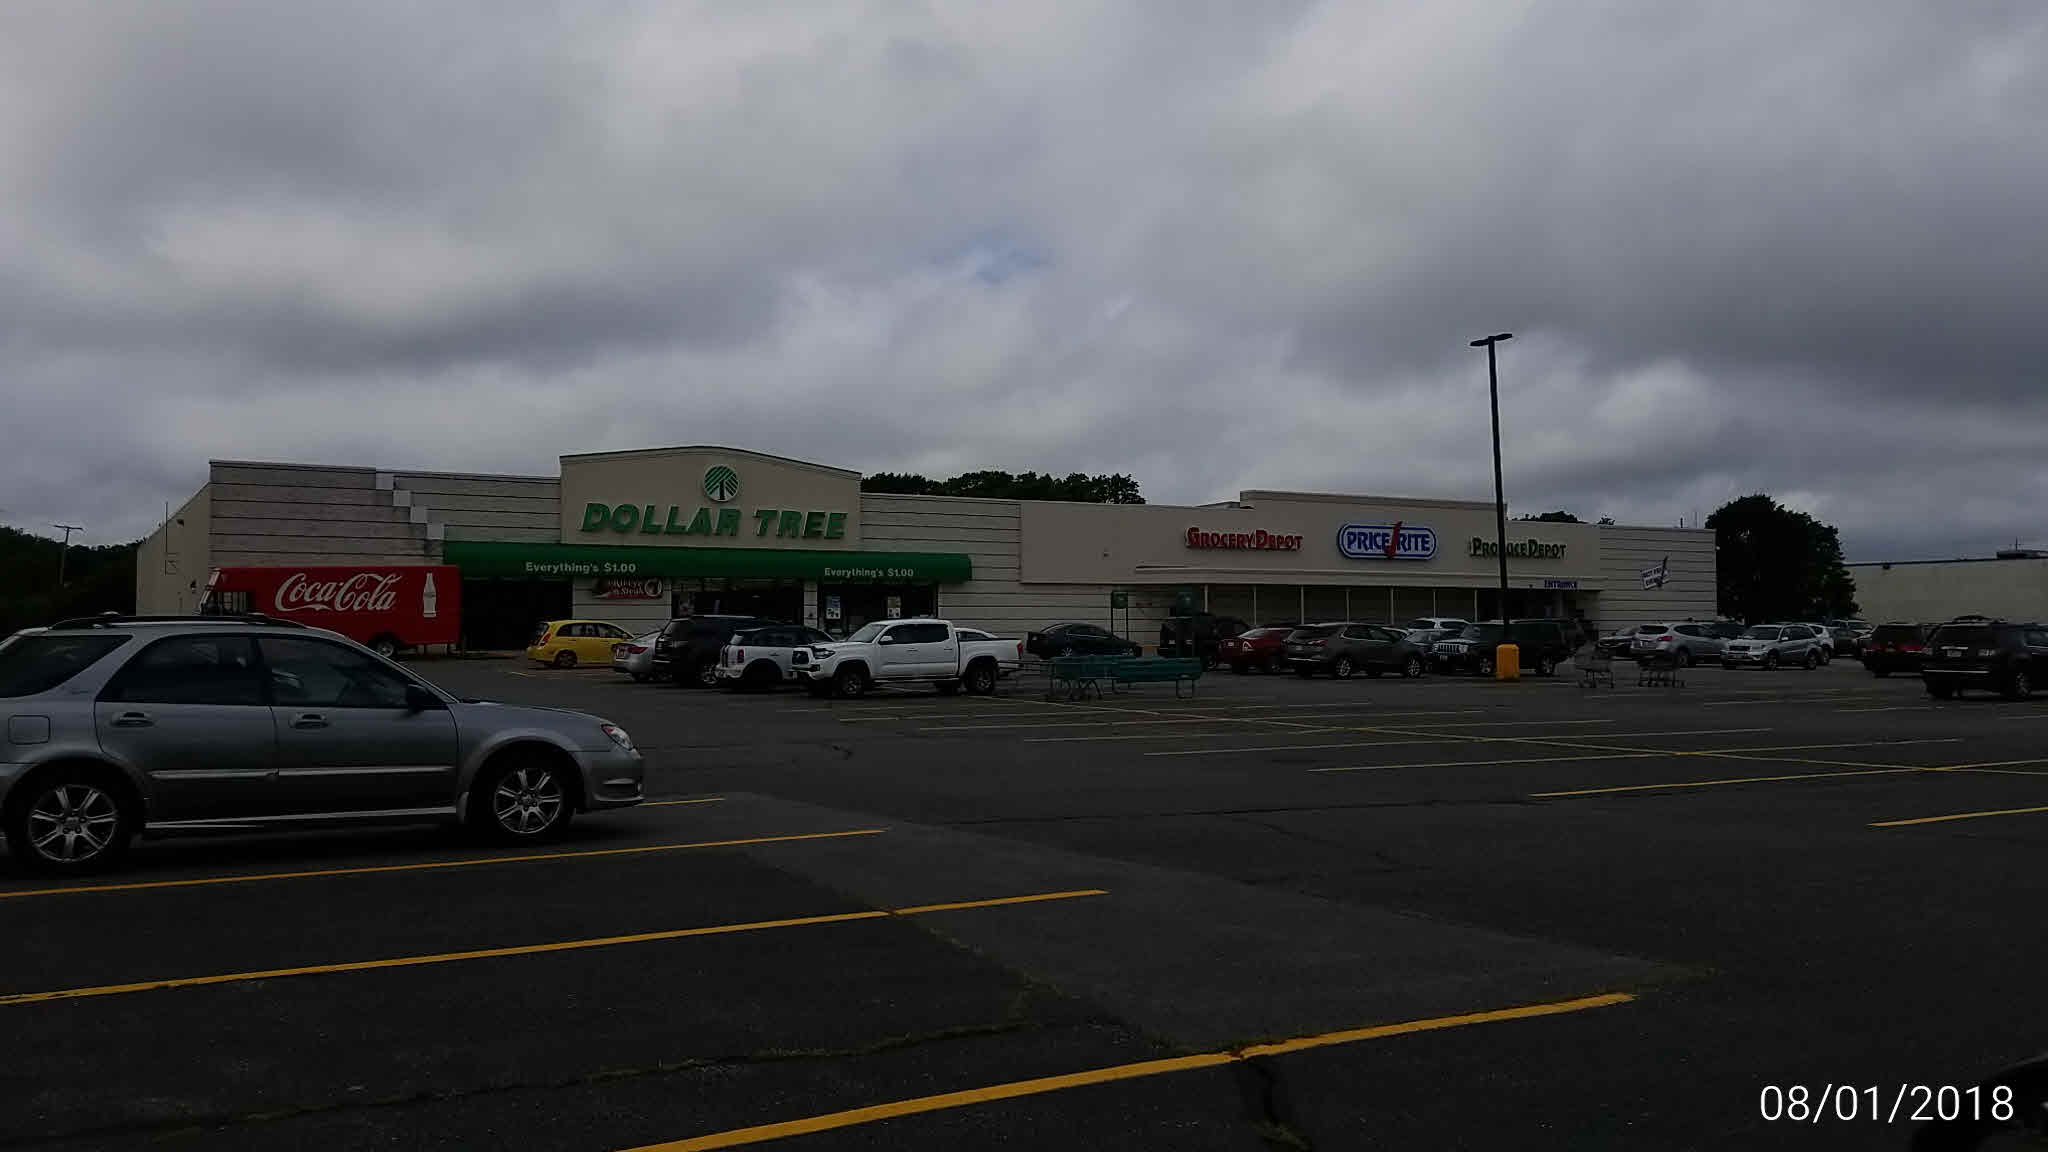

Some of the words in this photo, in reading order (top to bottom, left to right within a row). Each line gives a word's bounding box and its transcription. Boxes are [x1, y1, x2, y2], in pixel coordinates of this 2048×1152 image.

[580, 502, 741, 538] DOLLAR
[753, 508, 848, 540] TREE
[1186, 527, 1254, 550] GROCERY
[1346, 531, 1391, 552] PRICE
[1398, 533, 1431, 552] RITE
[1472, 537, 1527, 558] PROUCE
[1527, 539, 1567, 559] DEPOT
[525, 561, 599, 574] Everything's
[604, 561, 637, 573] $1.00
[824, 567, 884, 578] Everything's
[887, 567, 914, 577] $1.00
[274, 572, 401, 612] Coca-Cola
